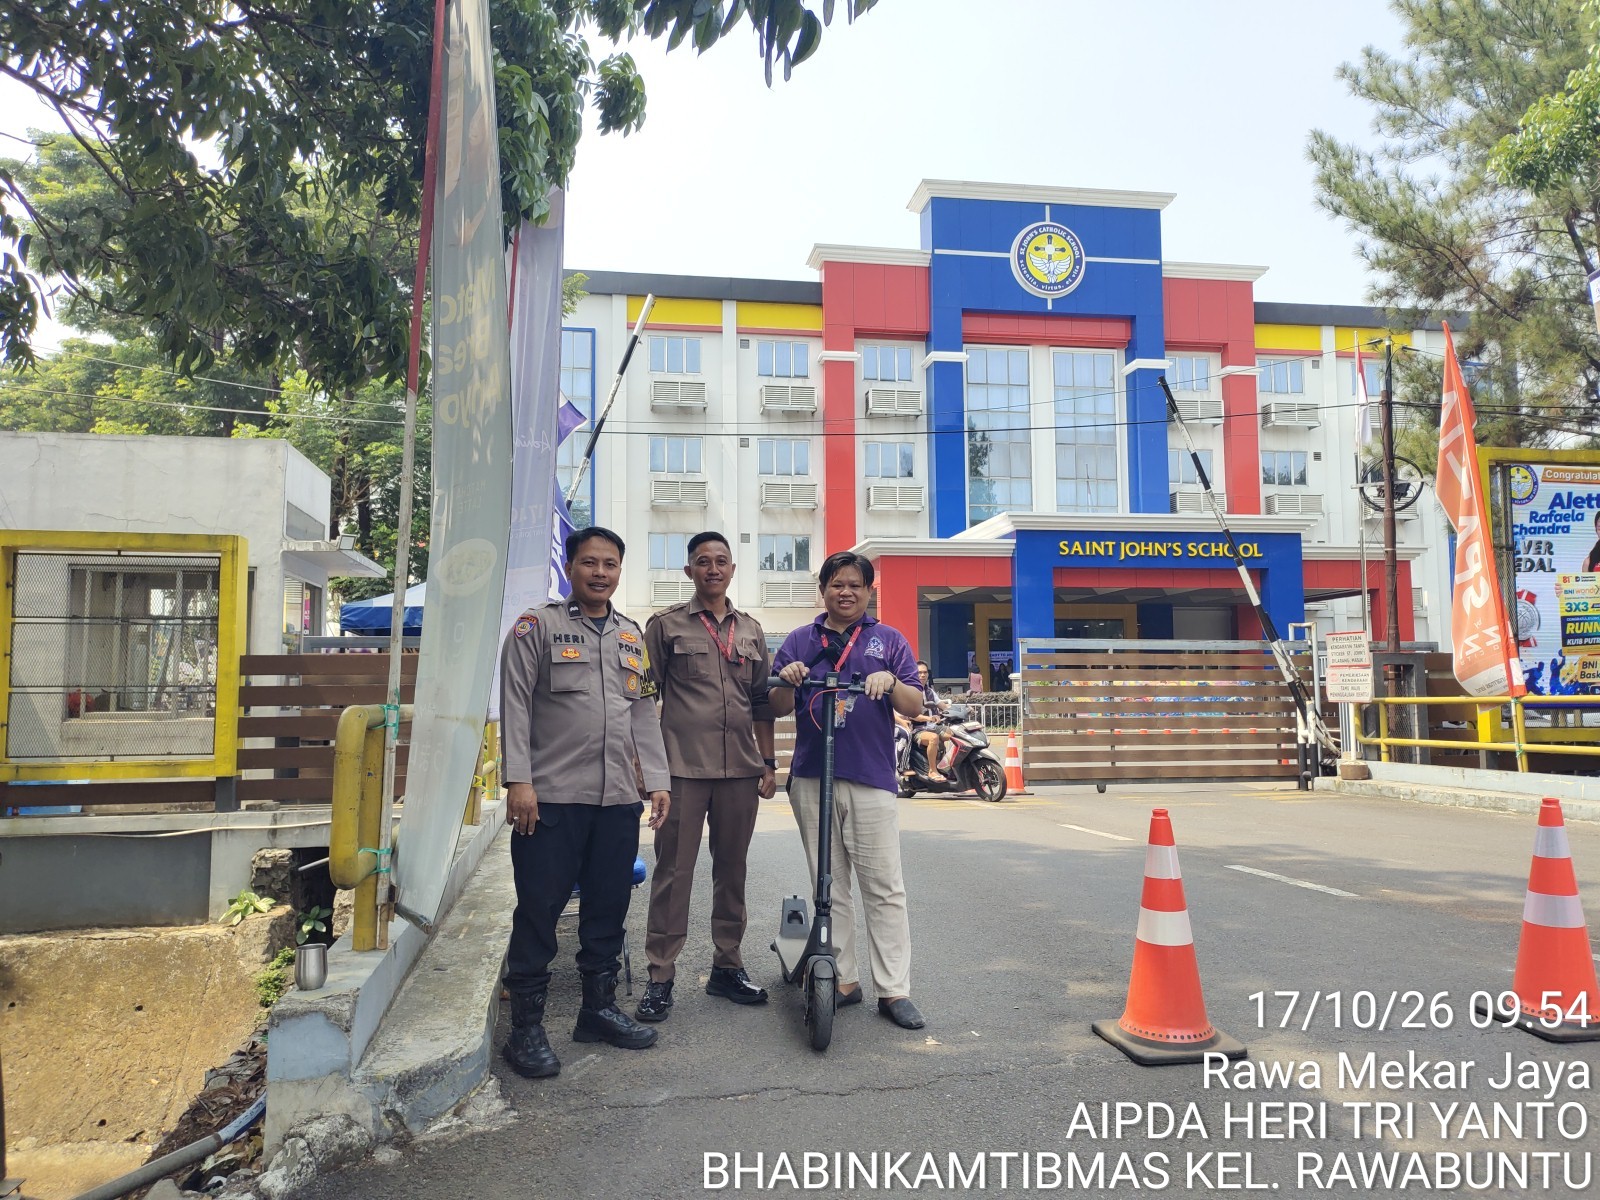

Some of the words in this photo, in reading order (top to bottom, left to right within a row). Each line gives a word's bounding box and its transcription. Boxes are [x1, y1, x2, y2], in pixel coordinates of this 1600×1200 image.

[1038, 226, 1067, 238] CATHOLIC
[1066, 235, 1081, 258] SCHOOL
[1529, 507, 1584, 523] Rafaela
[1513, 523, 1570, 535] Chandra
[1058, 540, 1116, 556] SAINT
[1119, 541, 1183, 560] JOHN'S
[553, 633, 585, 644] HERI
[617, 642, 642, 657] POLRI
[1582, 660, 1598, 669] BNI
